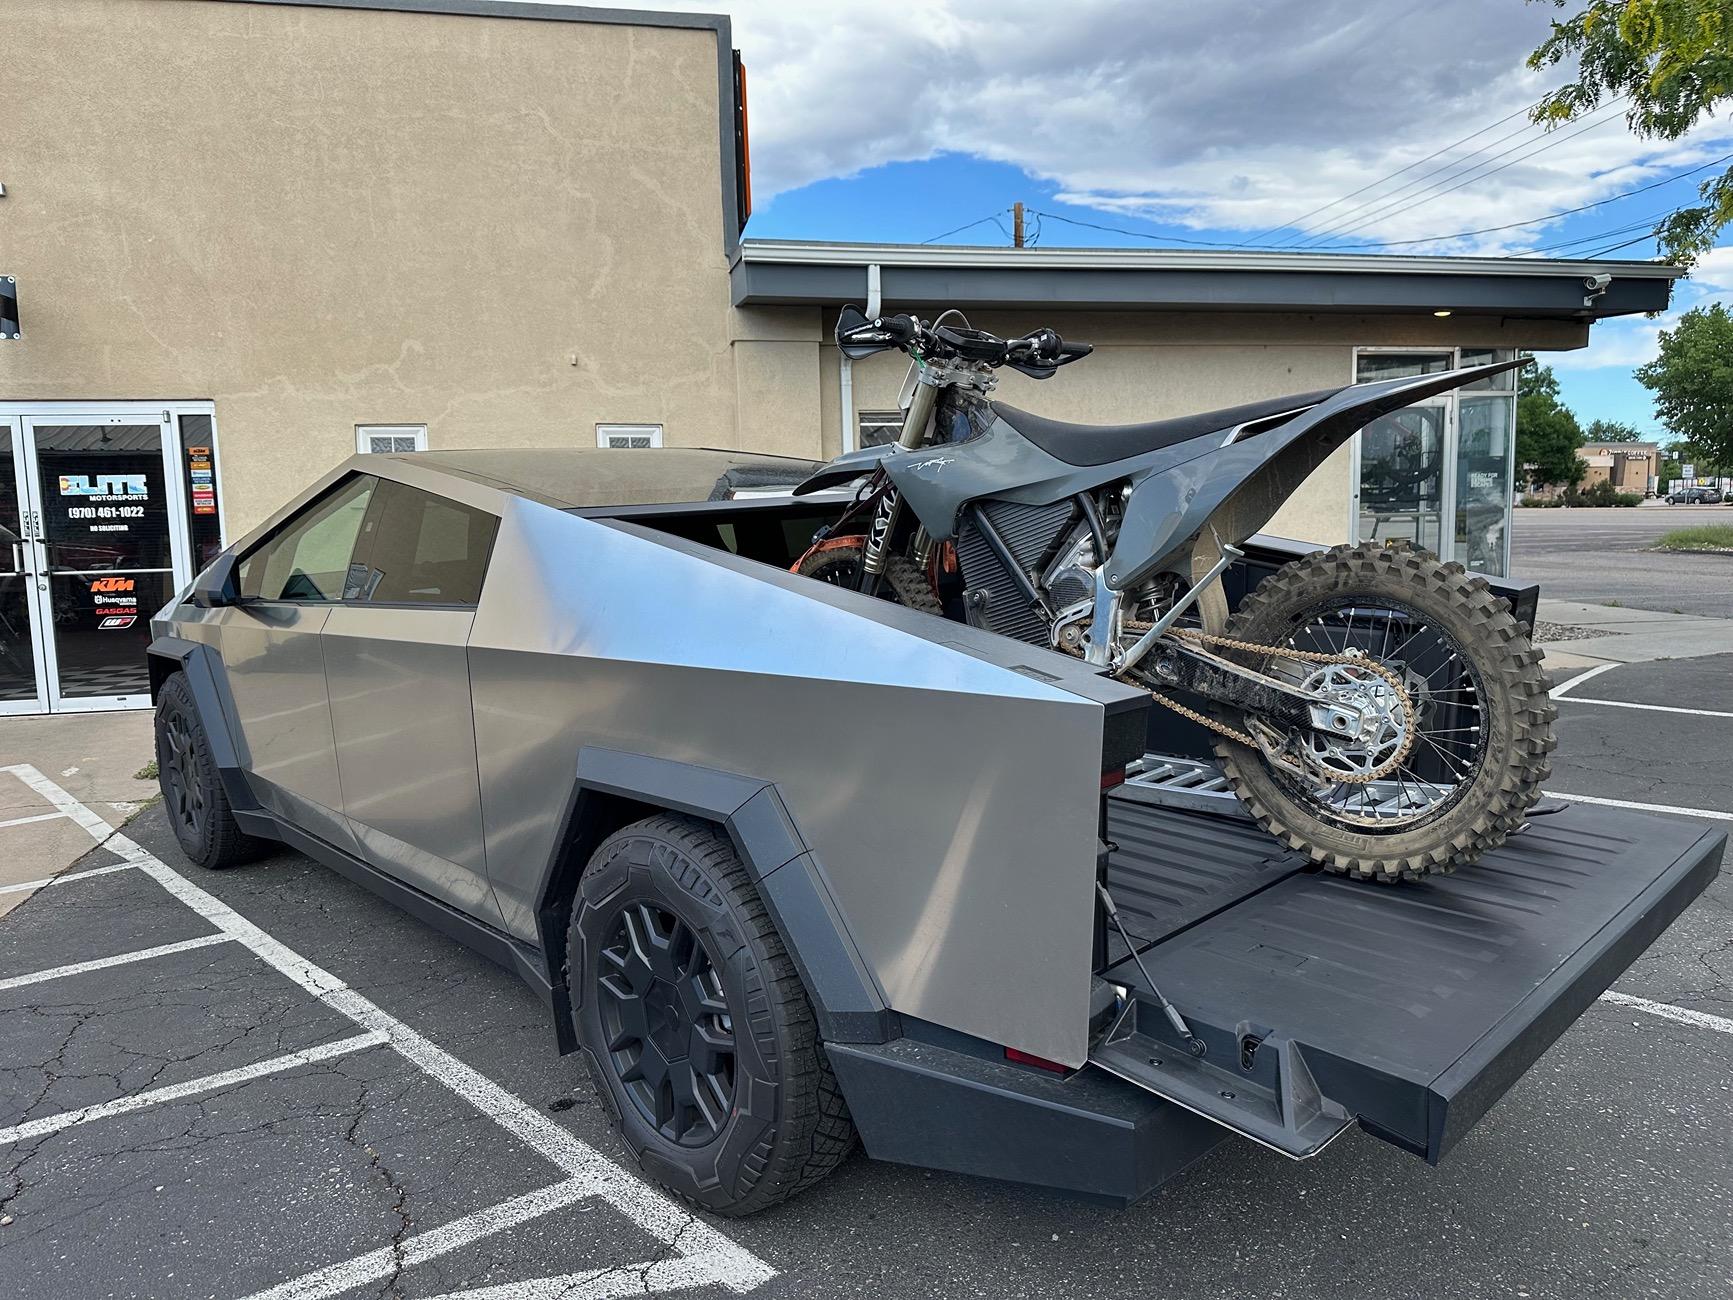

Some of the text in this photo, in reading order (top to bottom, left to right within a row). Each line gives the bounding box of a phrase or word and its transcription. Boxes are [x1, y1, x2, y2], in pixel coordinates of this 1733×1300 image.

[59, 474, 148, 495] ELITE
[89, 494, 149, 502] MOTORSPORTS
[68, 506, 145, 518] (970) 461-1022
[98, 524, 129, 532] SOLICITING
[91, 577, 134, 592] KTM
[102, 596, 137, 605] Husqvarna
